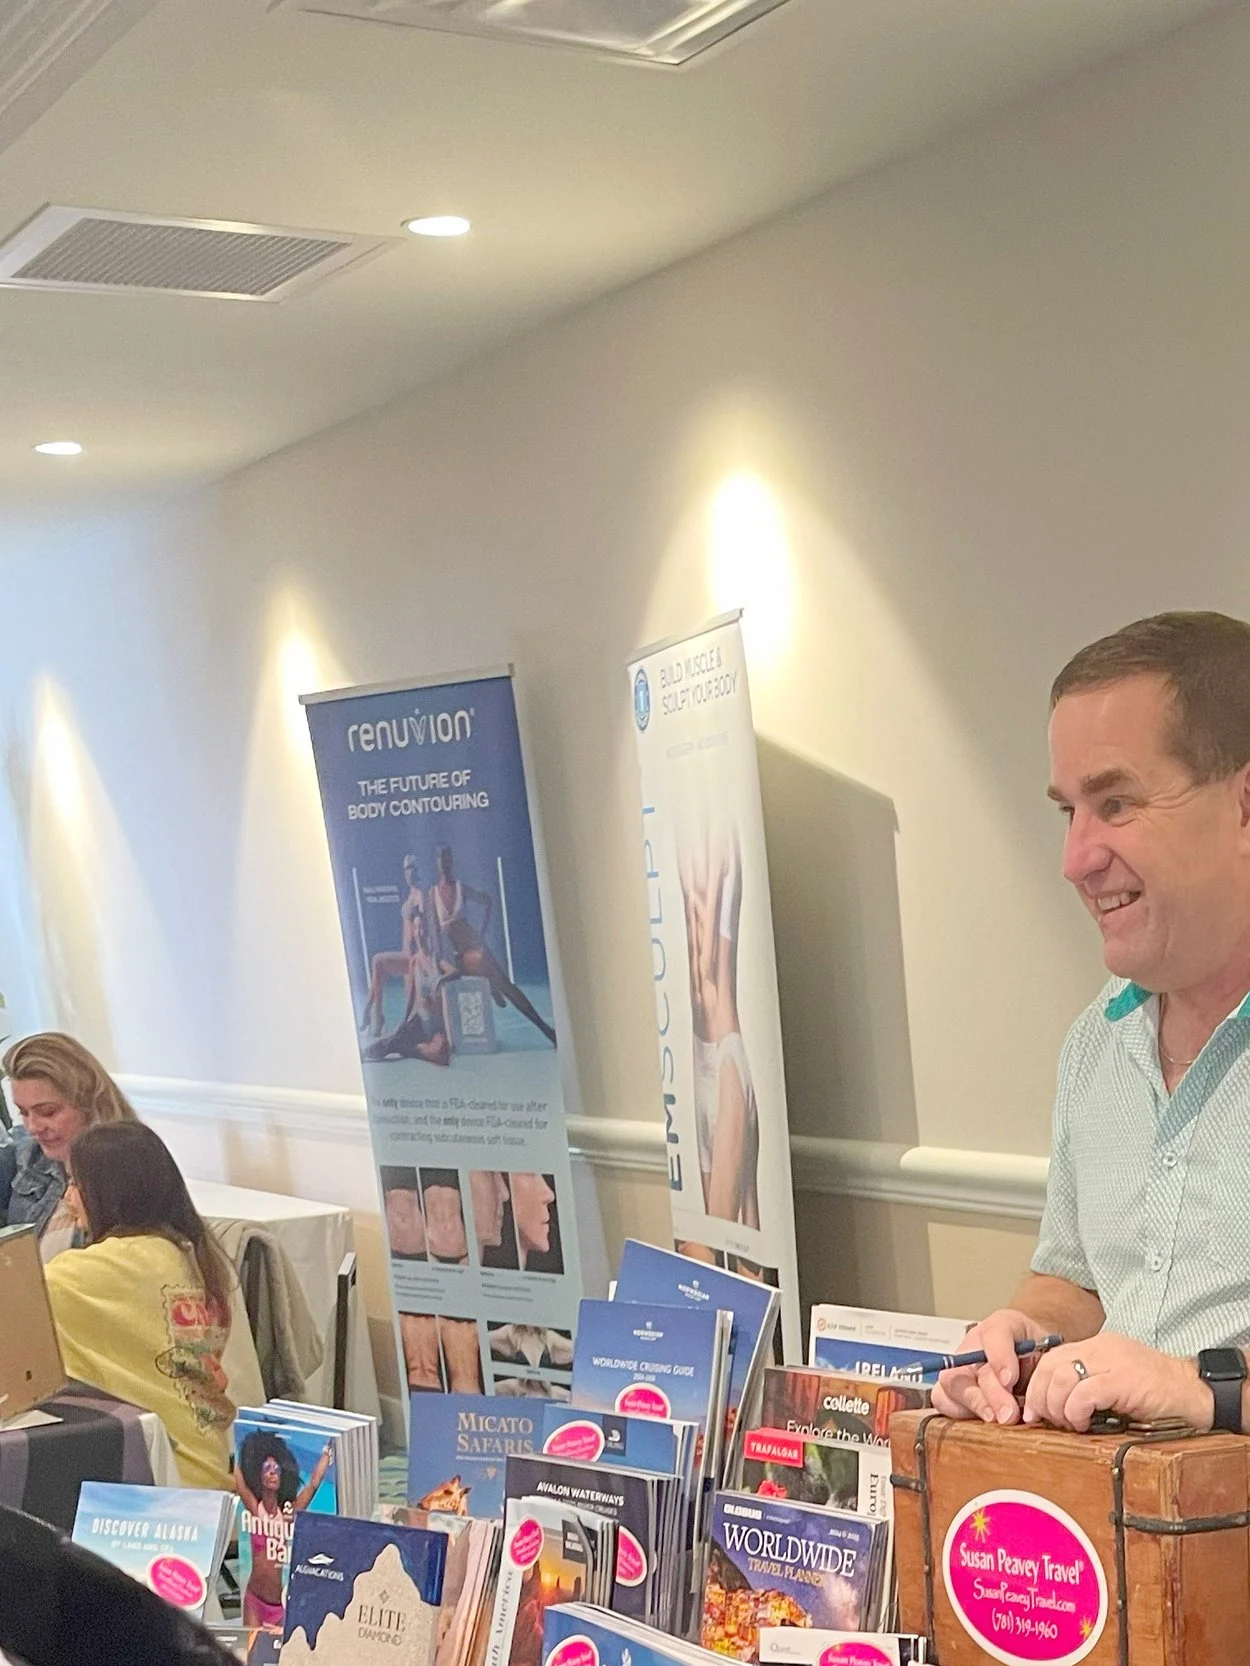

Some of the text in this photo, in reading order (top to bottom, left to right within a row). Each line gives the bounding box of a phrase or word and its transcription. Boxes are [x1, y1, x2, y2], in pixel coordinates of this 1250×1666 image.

[660, 663, 682, 688] BUILD
[685, 648, 714, 678] MUSCLE
[662, 670, 737, 715] SCULPT YOUR BODY
[358, 769, 471, 796] THE FUTURE OF
[348, 791, 490, 820] BODY CONTOURING
[592, 1357, 695, 1377] WORLDWIDE CRUISING GUIDE
[823, 1395, 870, 1415] collette
[458, 1412, 533, 1434] MICATO
[787, 1419, 833, 1439] Explore
[836, 1425, 860, 1443] the
[456, 1434, 533, 1454] SAFARIS
[750, 1441, 798, 1459] TRAFALGAR
[536, 1481, 625, 1507] AVALON WATERWAYS
[91, 1518, 200, 1542] DISCOVER ALASKA
[723, 1522, 857, 1577] WORLDWIDE
[748, 1557, 784, 1577] TRAVEL
[960, 1542, 994, 1571] Susan
[997, 1548, 1039, 1584] Peavey
[494, 1571, 513, 1639] America
[973, 1578, 1075, 1613] SusanPeaveyTravel.com
[358, 1605, 407, 1632] ELITE
[992, 1608, 1058, 1640] (781) 319-1960
[358, 1626, 402, 1646] DIAMOND
